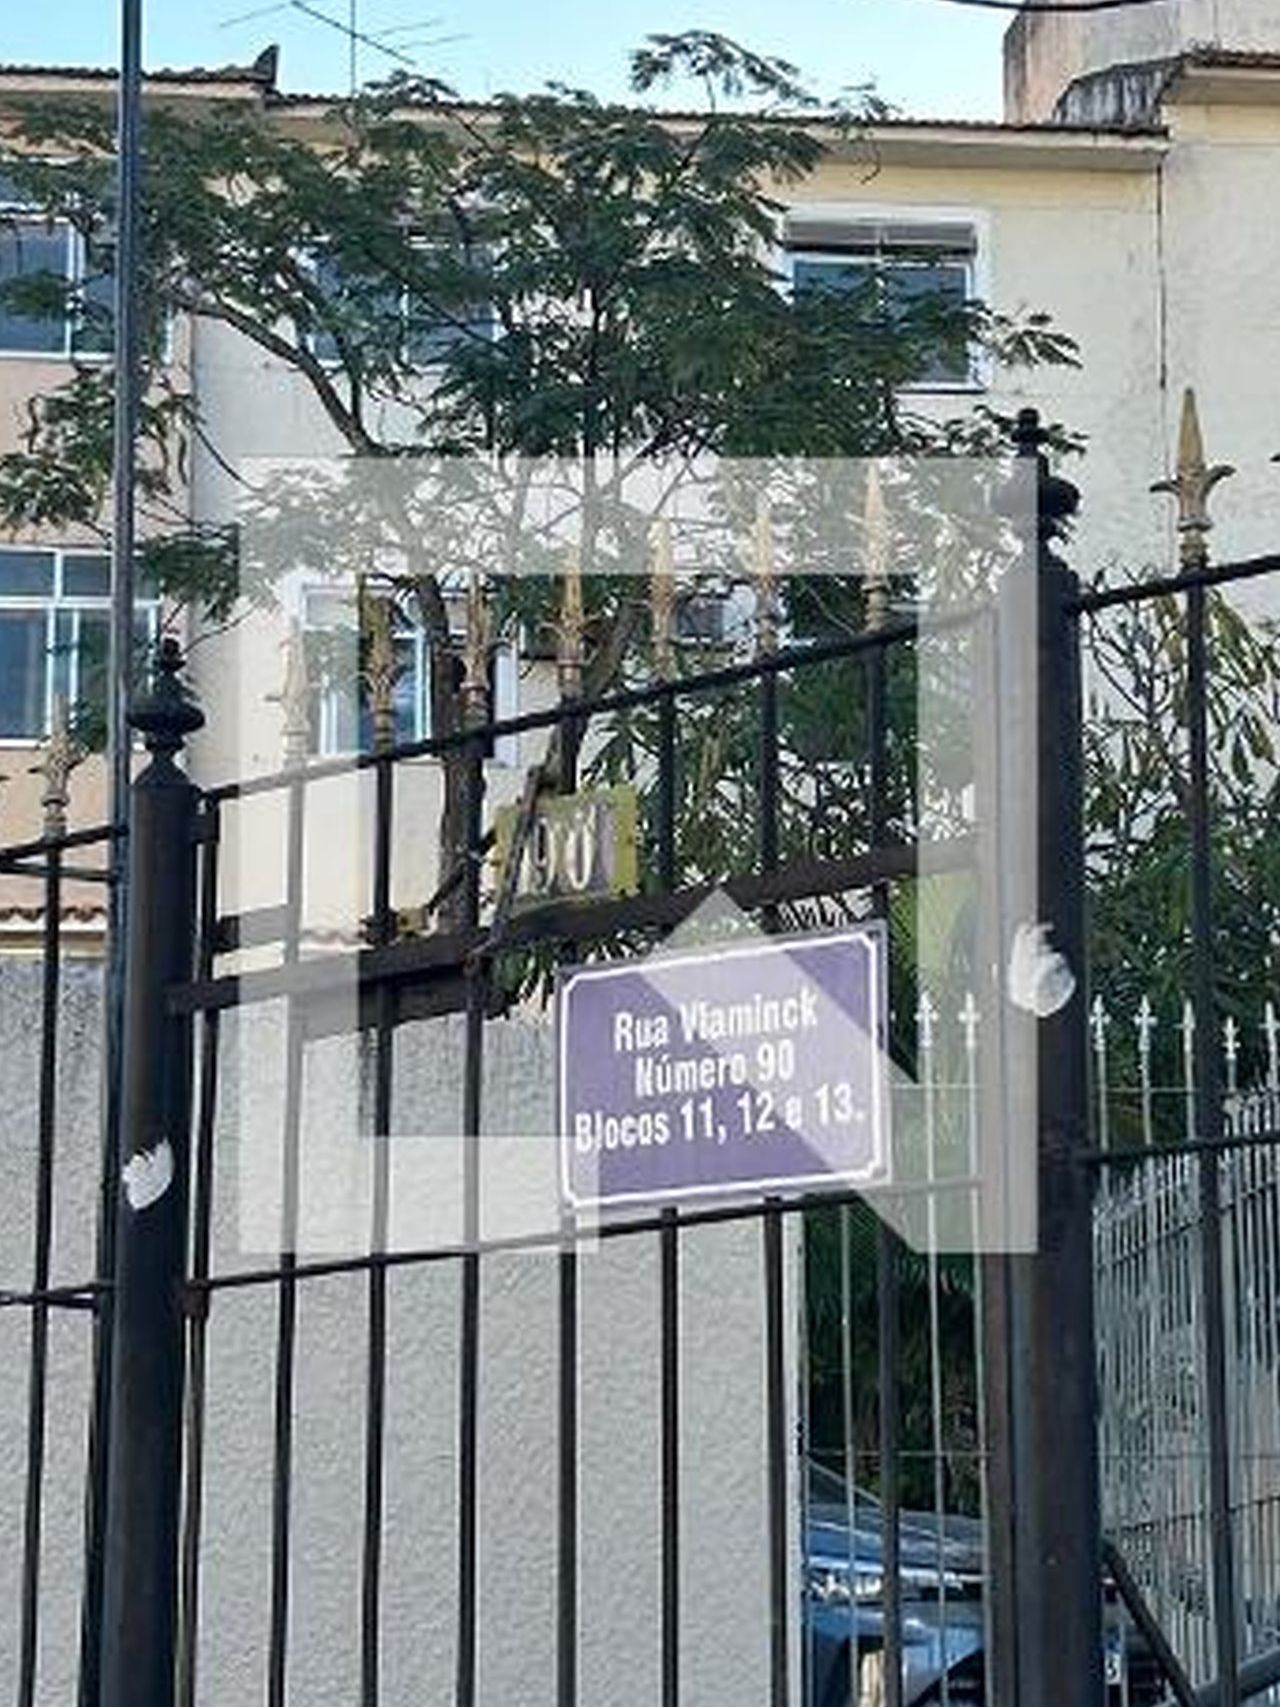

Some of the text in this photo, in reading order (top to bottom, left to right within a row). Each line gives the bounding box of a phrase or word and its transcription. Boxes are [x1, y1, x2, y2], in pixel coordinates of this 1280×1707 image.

[614, 988, 818, 1051] Rua Vlaminck
[635, 1039, 795, 1097] Número 90
[574, 1082, 866, 1152] Blocos 11, 12 e 13.
